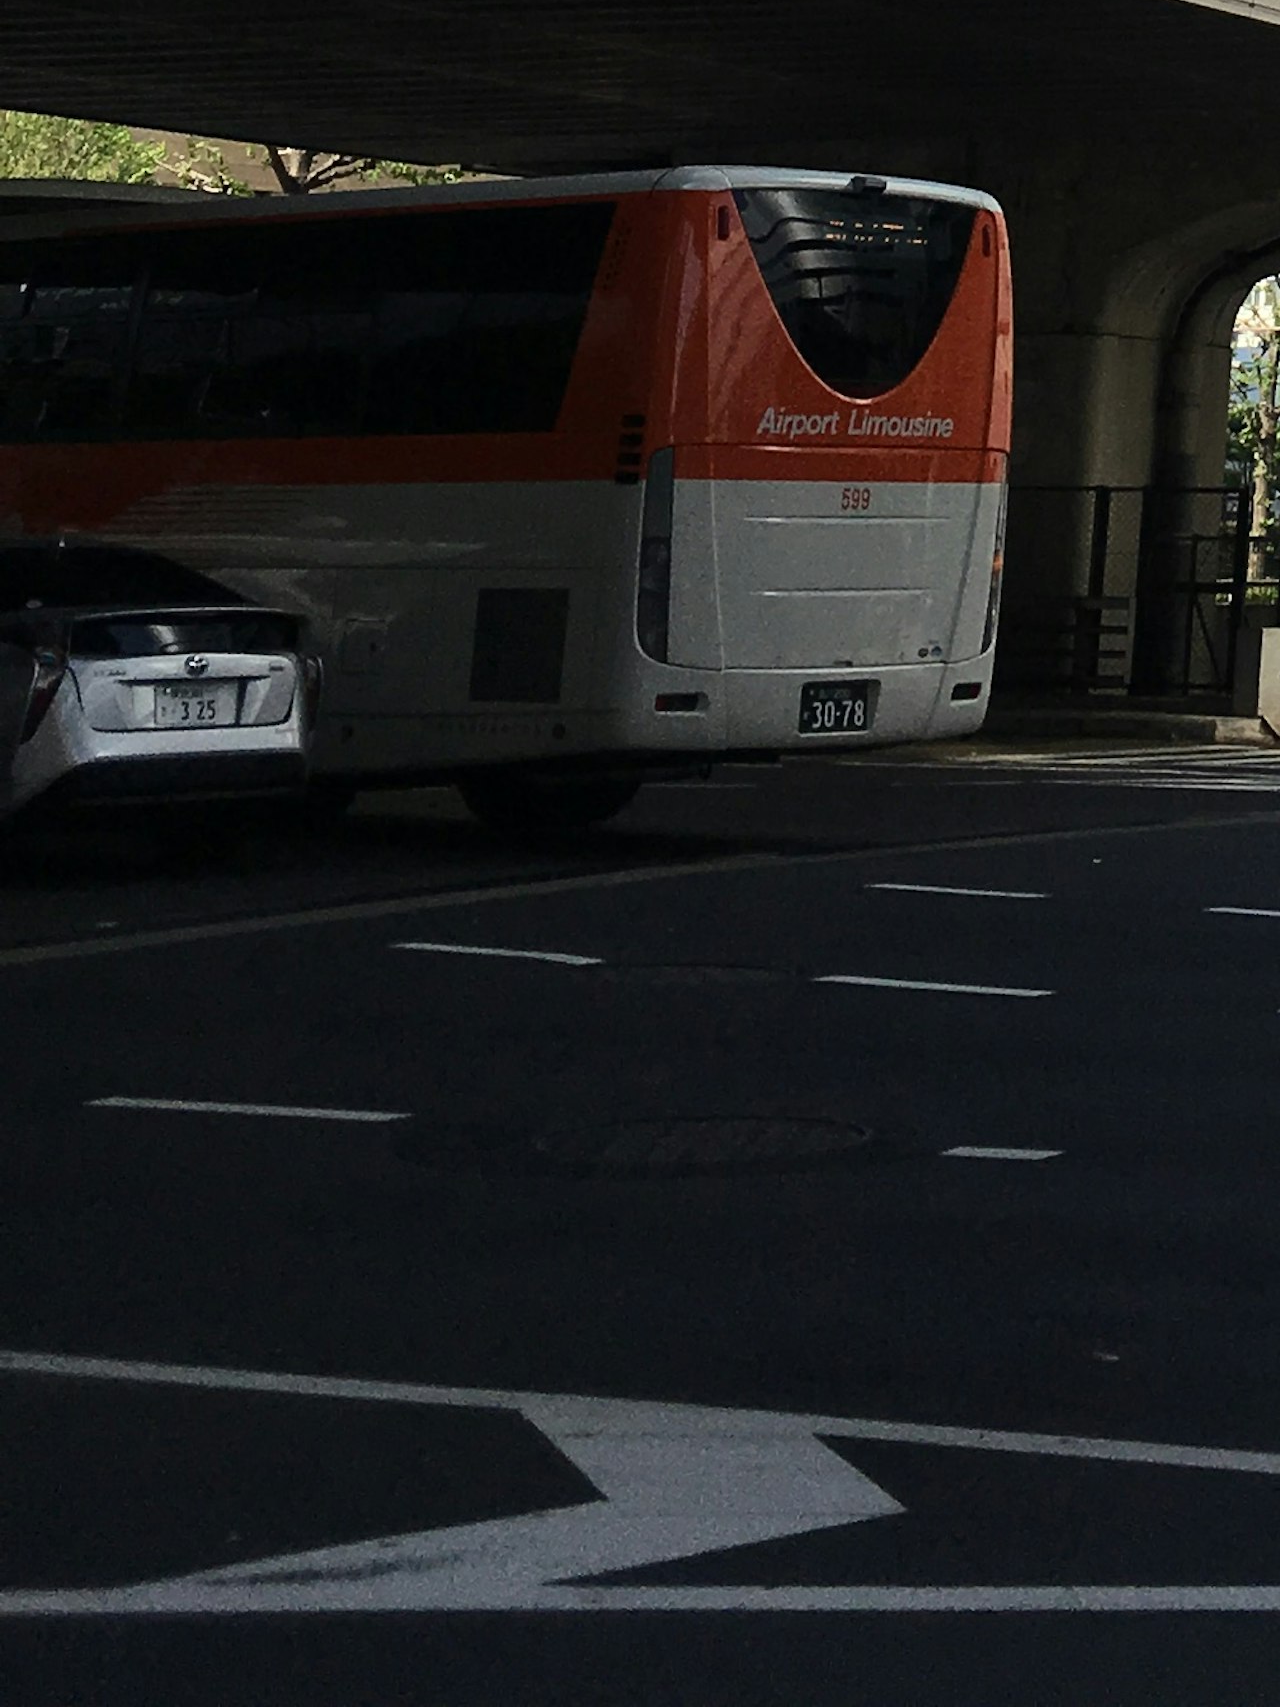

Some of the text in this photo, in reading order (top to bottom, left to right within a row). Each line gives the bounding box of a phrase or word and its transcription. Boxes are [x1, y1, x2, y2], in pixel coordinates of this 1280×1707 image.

[756, 406, 954, 439] Airport Limousine
[841, 488, 870, 511] 599
